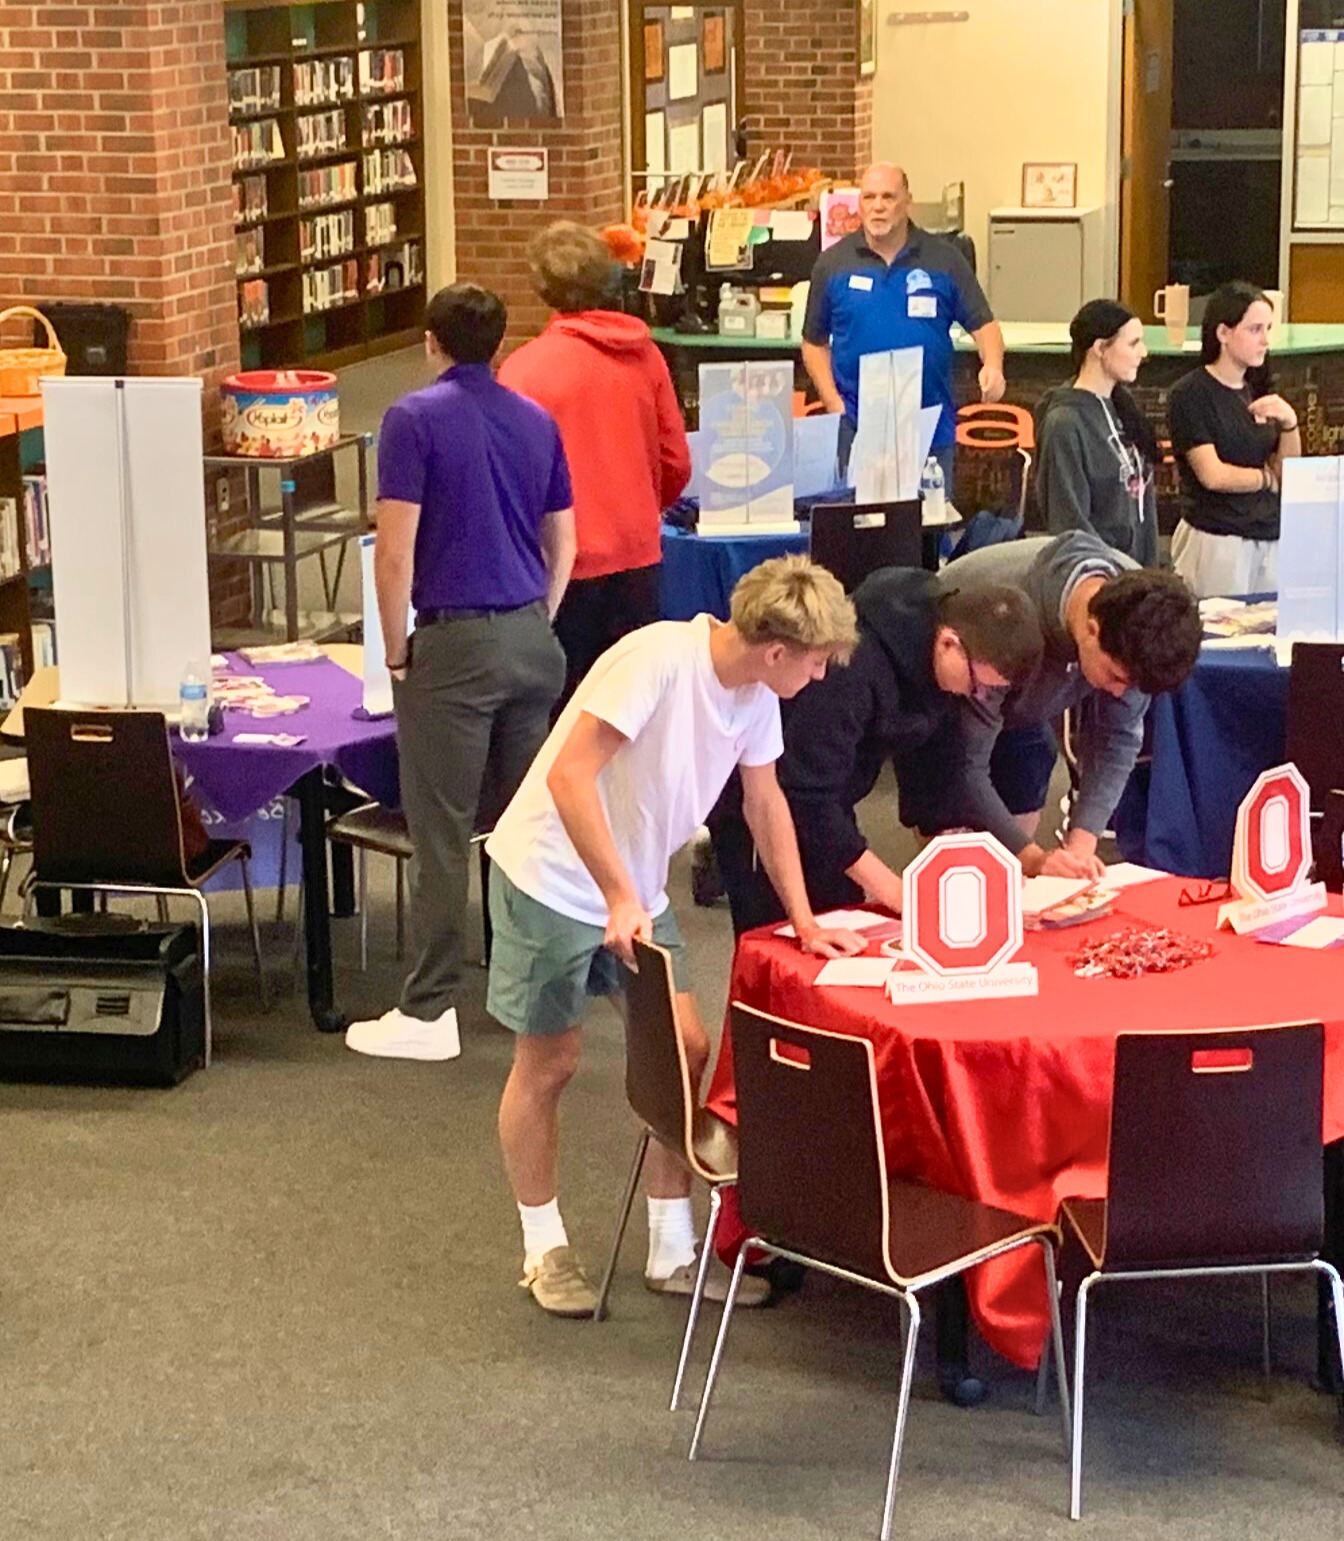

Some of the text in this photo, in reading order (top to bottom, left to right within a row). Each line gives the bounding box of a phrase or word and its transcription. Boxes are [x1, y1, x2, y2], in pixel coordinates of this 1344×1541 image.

[895, 975, 1033, 993] The Ohio State University
